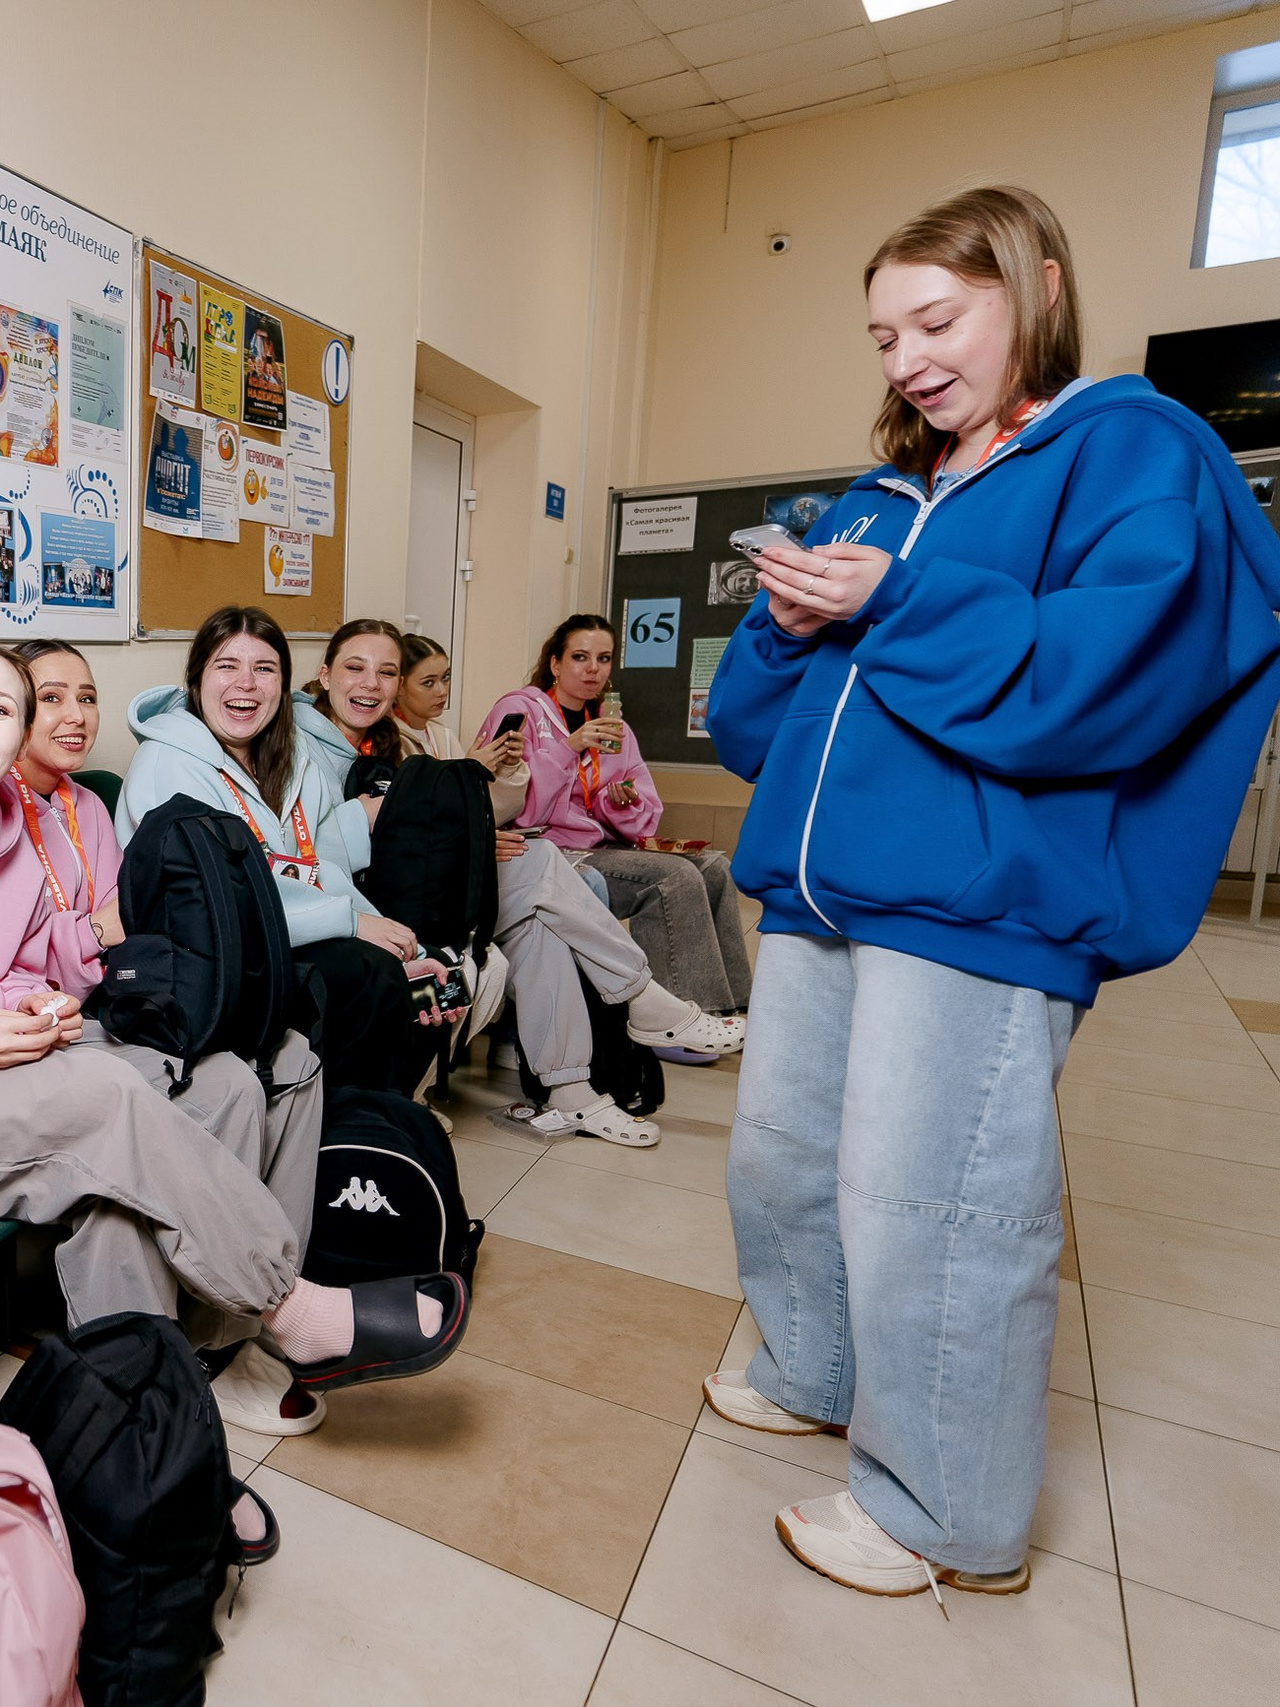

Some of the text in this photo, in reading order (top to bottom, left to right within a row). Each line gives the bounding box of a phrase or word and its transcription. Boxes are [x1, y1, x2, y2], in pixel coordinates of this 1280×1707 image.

[20, 204, 120, 265] объединение
[13, 352, 43, 370] ДИПЛОМ
[246, 449, 285, 470] ПЕРВОКУРСНИК
[633, 504, 682, 514] Фотогалерея
[654, 516, 690, 525] красивая
[630, 611, 676, 644] 65
